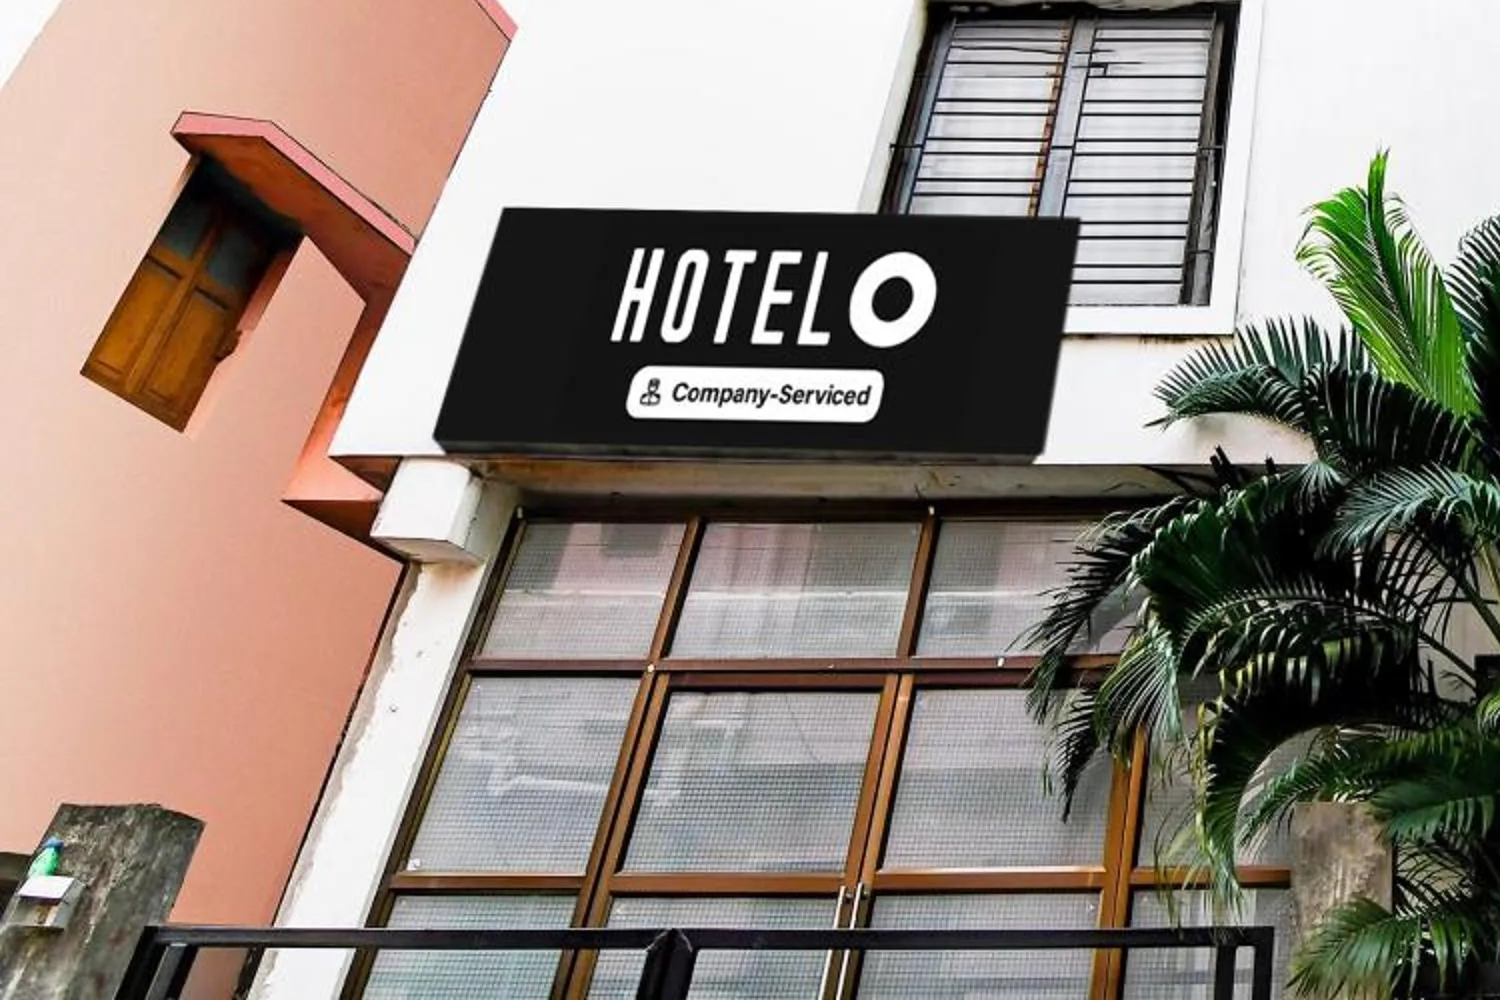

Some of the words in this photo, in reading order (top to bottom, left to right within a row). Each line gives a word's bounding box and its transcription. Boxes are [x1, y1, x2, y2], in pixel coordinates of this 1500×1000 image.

[611, 248, 831, 346] HOTEL
[849, 251, 937, 348] O
[672, 381, 871, 408] Company-Serviced
